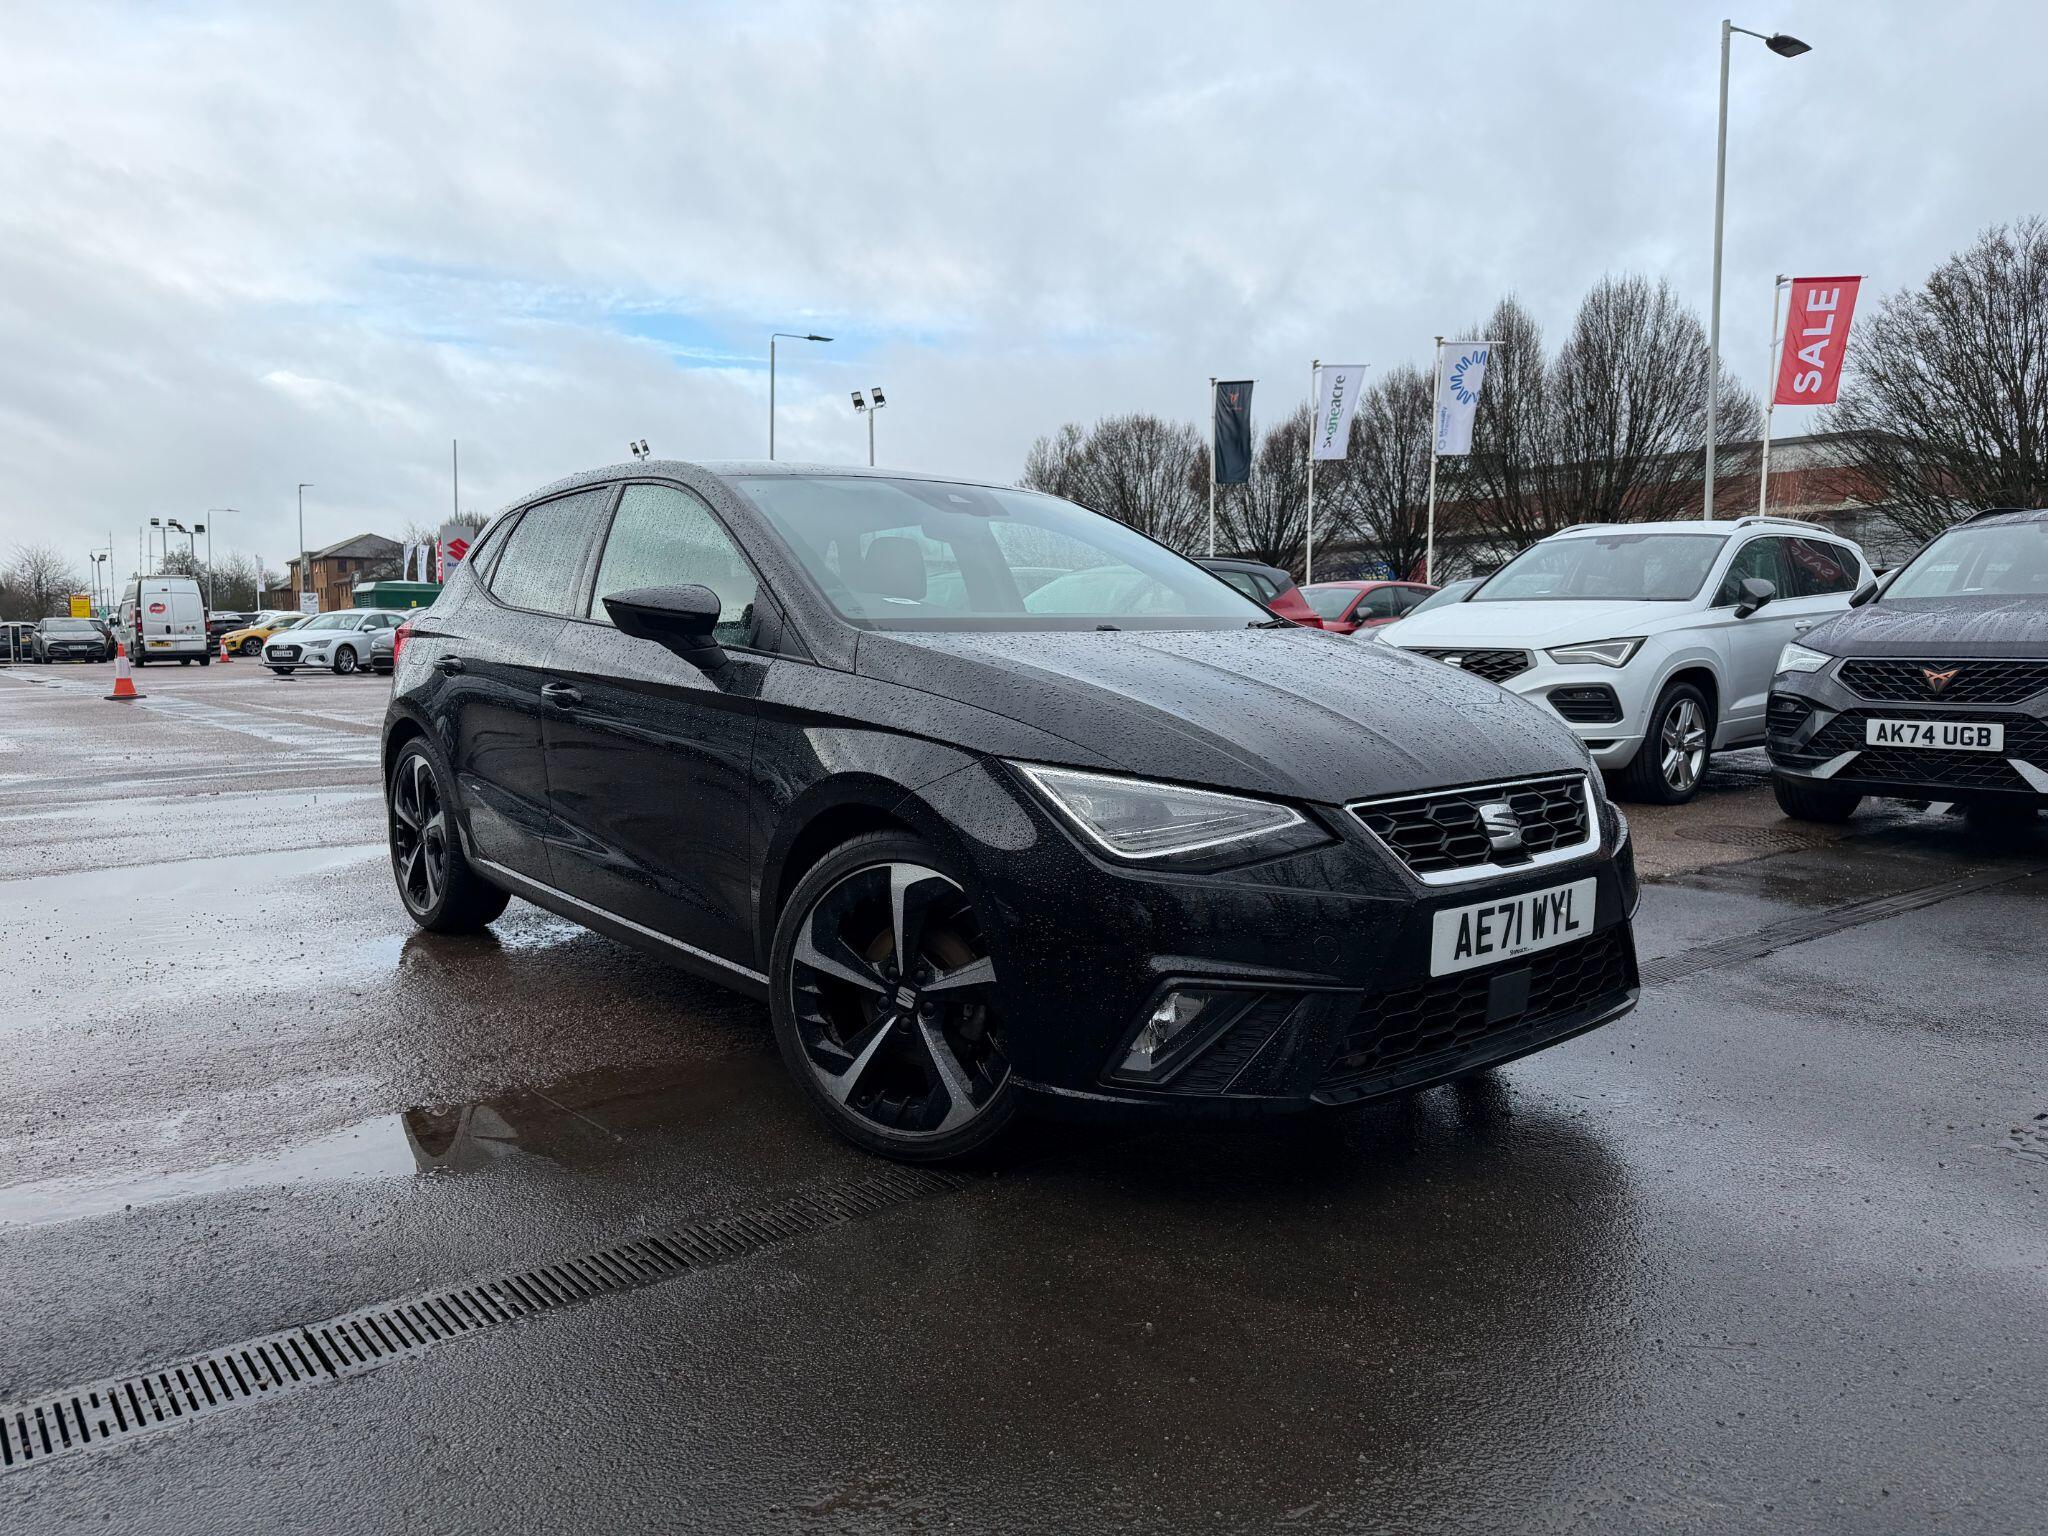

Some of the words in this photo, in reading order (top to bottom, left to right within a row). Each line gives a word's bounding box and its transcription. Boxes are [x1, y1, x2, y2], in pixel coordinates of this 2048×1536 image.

[1793, 287, 1840, 394] SALE
[1876, 723, 1936, 745] AK74
[1943, 725, 1992, 747] UGB
[1453, 900, 1524, 960] AE71
[1532, 888, 1580, 941] WYL
